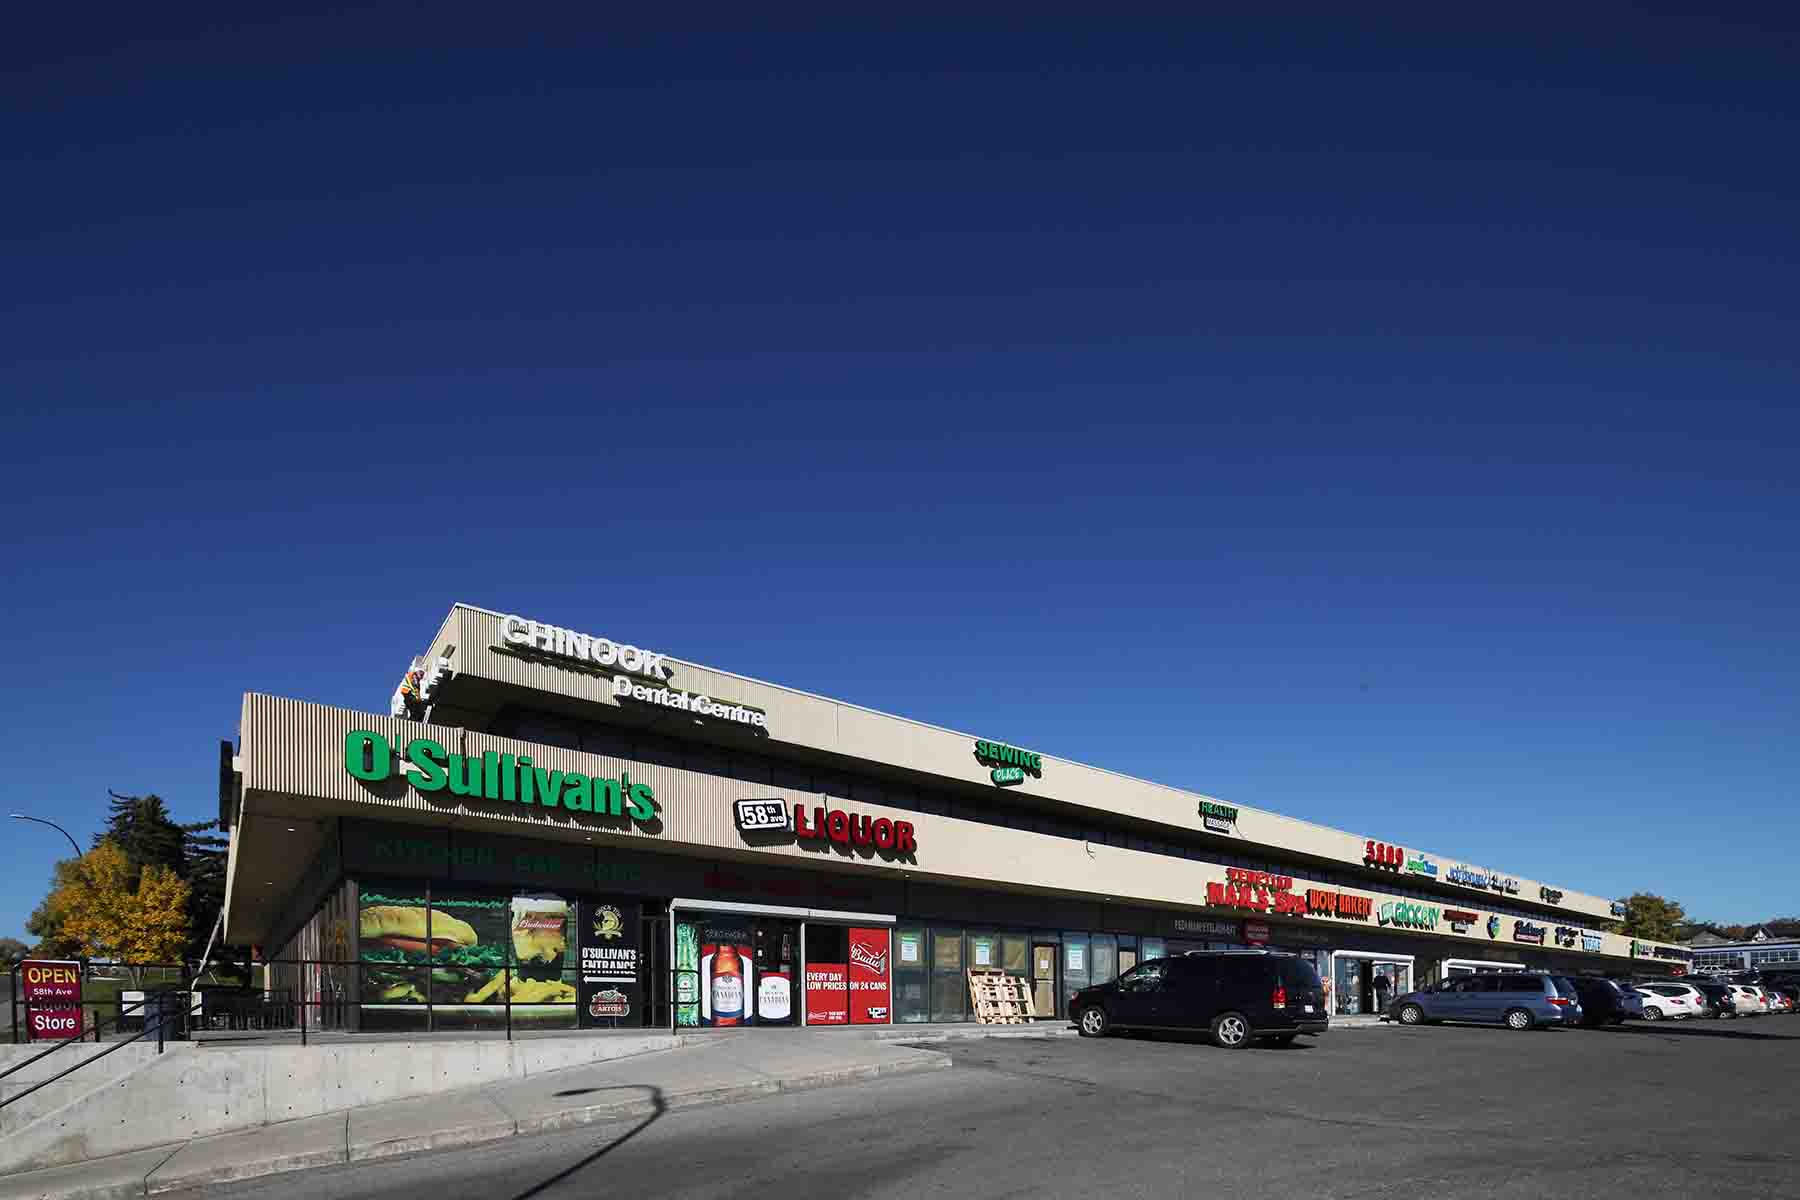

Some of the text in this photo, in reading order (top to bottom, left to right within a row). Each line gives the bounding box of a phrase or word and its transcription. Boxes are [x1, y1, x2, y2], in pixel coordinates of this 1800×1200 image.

[502, 614, 668, 680] CHINOOK
[613, 675, 767, 728] Dental Centre
[977, 740, 1041, 769] SEWING
[345, 729, 655, 821] O'Sullivan's
[1201, 802, 1239, 819] HEALTHY
[794, 803, 914, 853] LIQUOR
[1206, 881, 1269, 911] NAILS
[1309, 888, 1373, 917] WOW BAKERY
[1395, 901, 1440, 927] GROCERY
[582, 947, 637, 961] O'SULLIVAN'S
[28, 967, 77, 984] OPEN
[582, 960, 637, 975] ENTRANCE
[806, 972, 842, 981] EVERY DAY
[33, 987, 73, 996] 58th Ave
[806, 981, 887, 991] LOW PRICES ON 24 CANS
[34, 1014, 76, 1031] Store
